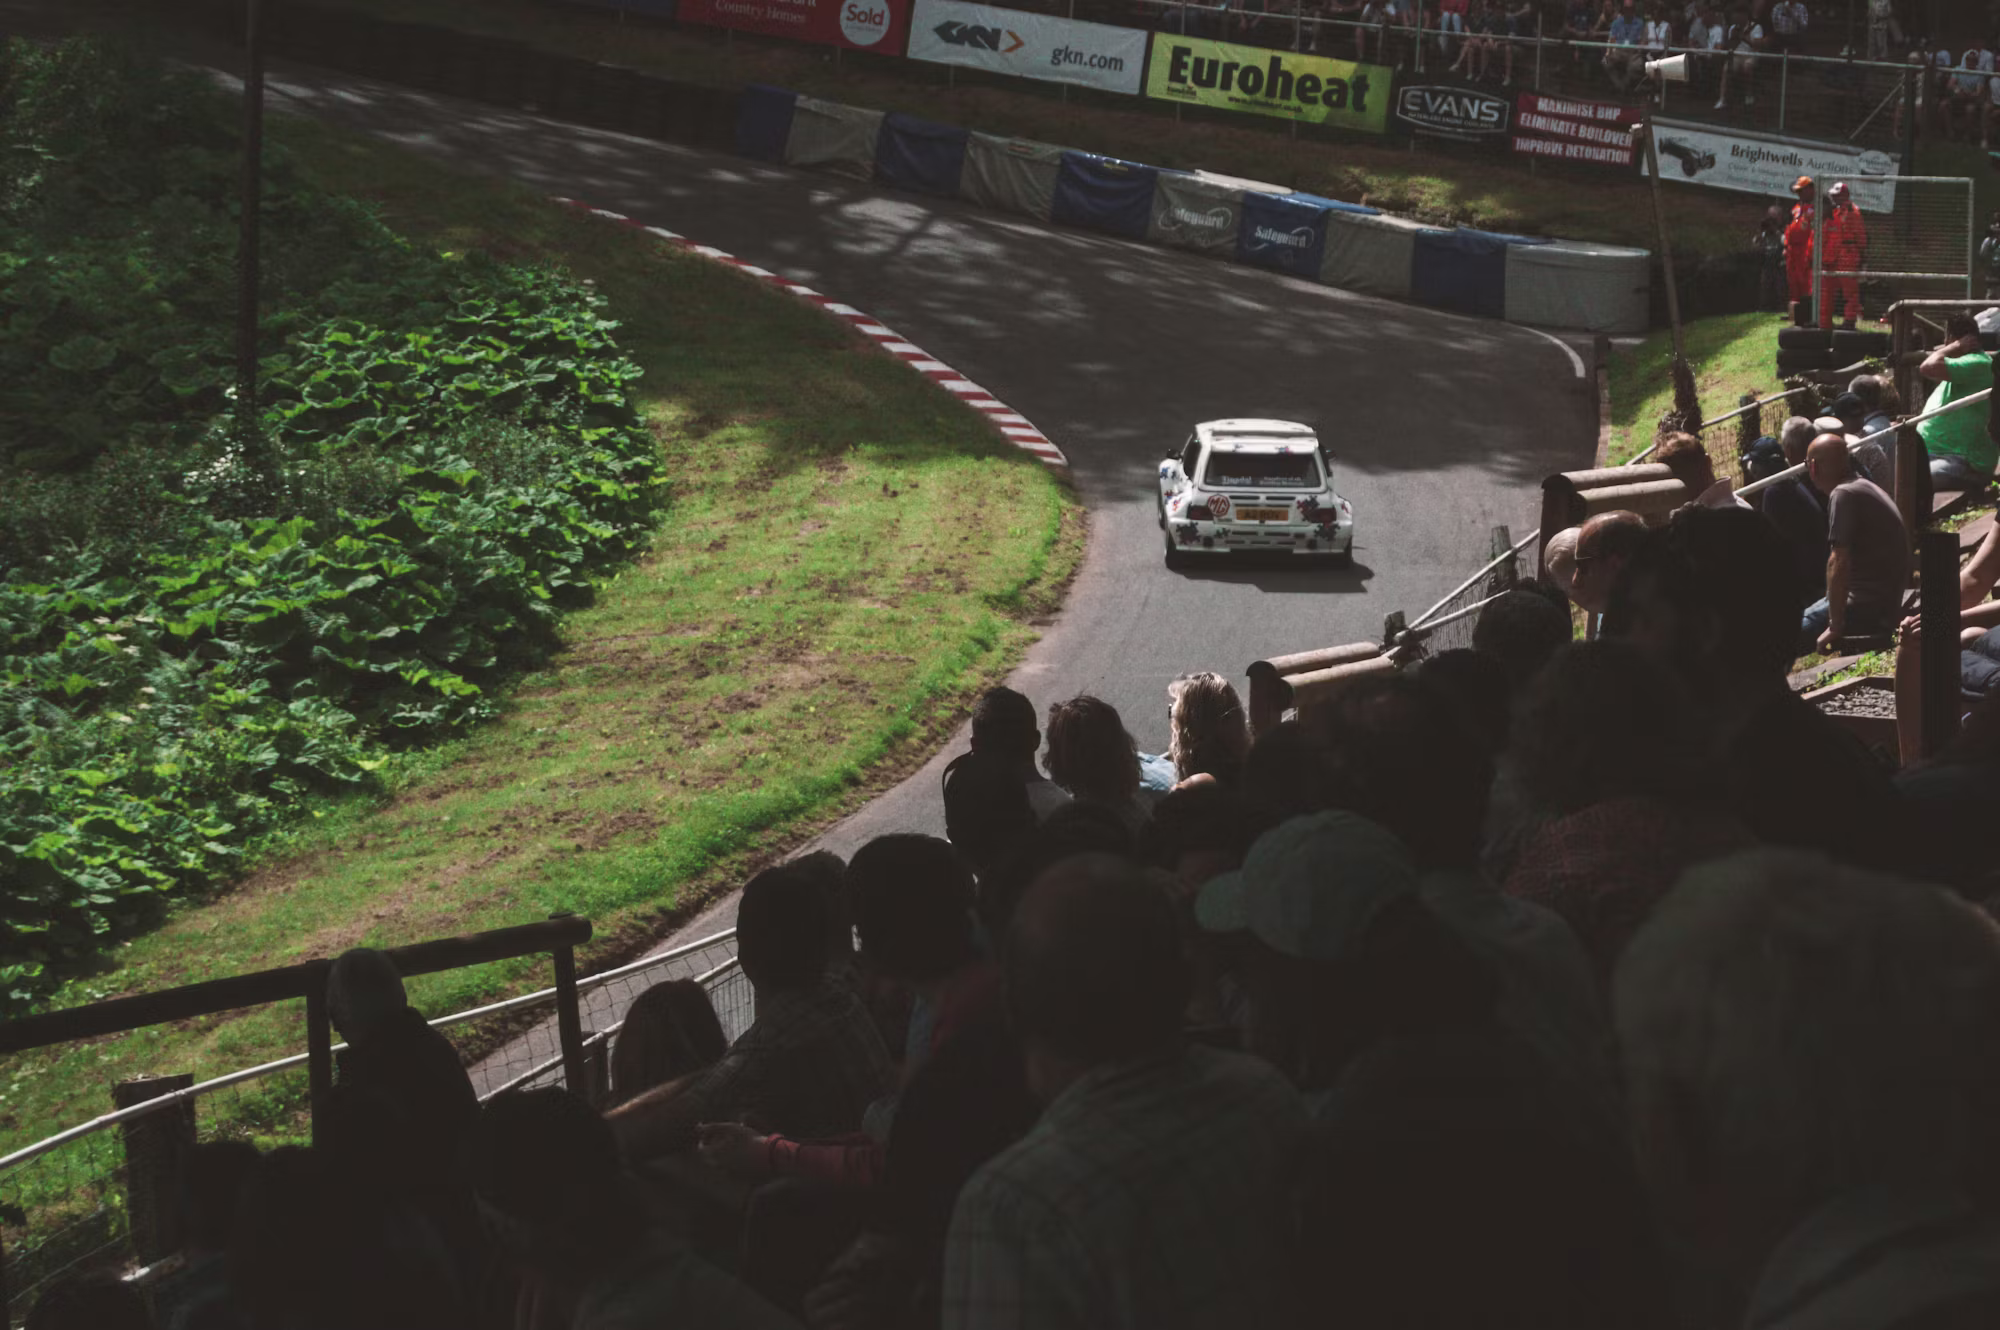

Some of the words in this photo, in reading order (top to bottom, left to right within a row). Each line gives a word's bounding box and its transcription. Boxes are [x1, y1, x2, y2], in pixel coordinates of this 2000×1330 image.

[768, 6, 806, 23] Homes
[846, 4, 885, 26] Sold
[1050, 45, 1124, 72] gkn.com
[1169, 45, 1370, 112] Euroheat
[1404, 90, 1500, 122] EVANS
[1537, 97, 1594, 118] MAXIMISE
[1597, 105, 1622, 120] BHP
[1520, 113, 1577, 136] ELIMINATE
[1578, 124, 1633, 147] BOILOVER
[1516, 137, 1563, 155] IMPROVE
[1565, 143, 1631, 163] DETONATION
[1731, 144, 1804, 166] Brightwells
[1806, 157, 1853, 174] Auctions
[1255, 225, 1307, 248] Safeguard
[1209, 497, 1228, 515] MG
